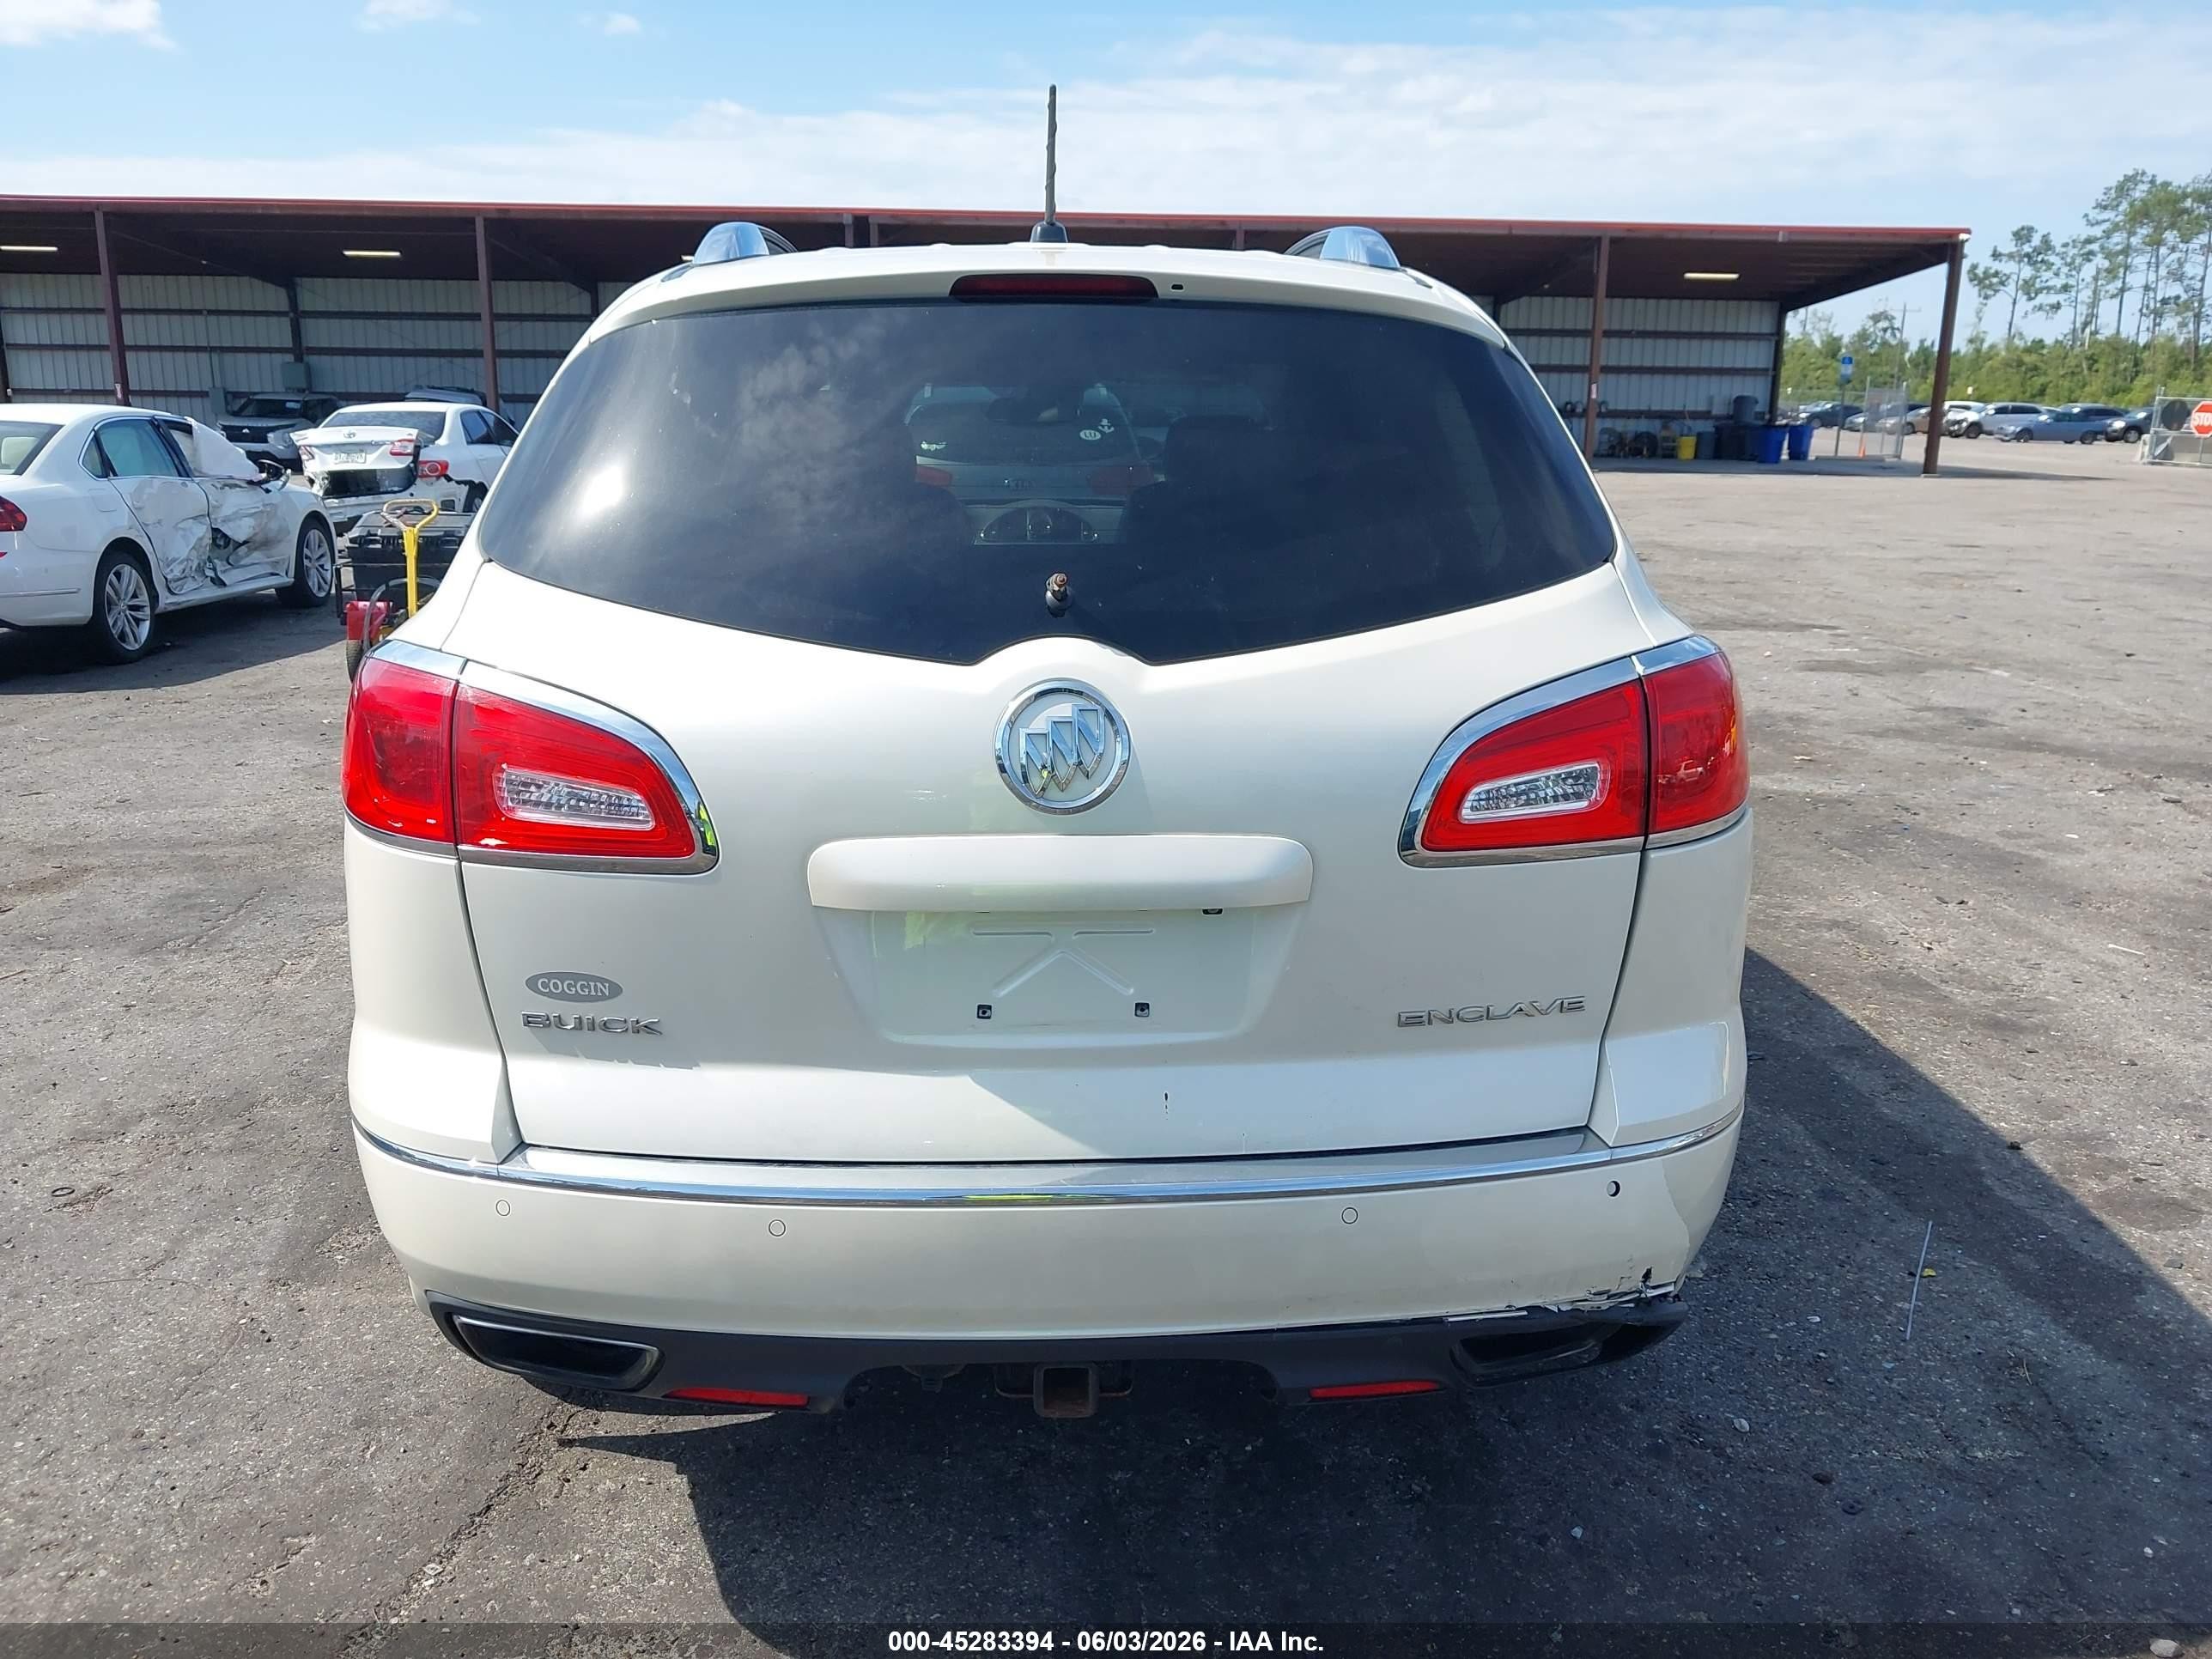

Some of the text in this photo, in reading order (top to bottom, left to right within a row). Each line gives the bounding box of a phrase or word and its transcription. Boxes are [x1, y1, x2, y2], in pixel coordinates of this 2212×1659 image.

[2192, 412, 2212, 426] STO
[537, 977, 610, 996] COGGIN
[521, 1010, 663, 1036] BUICK
[1397, 996, 1585, 1028] ENCLAVE
